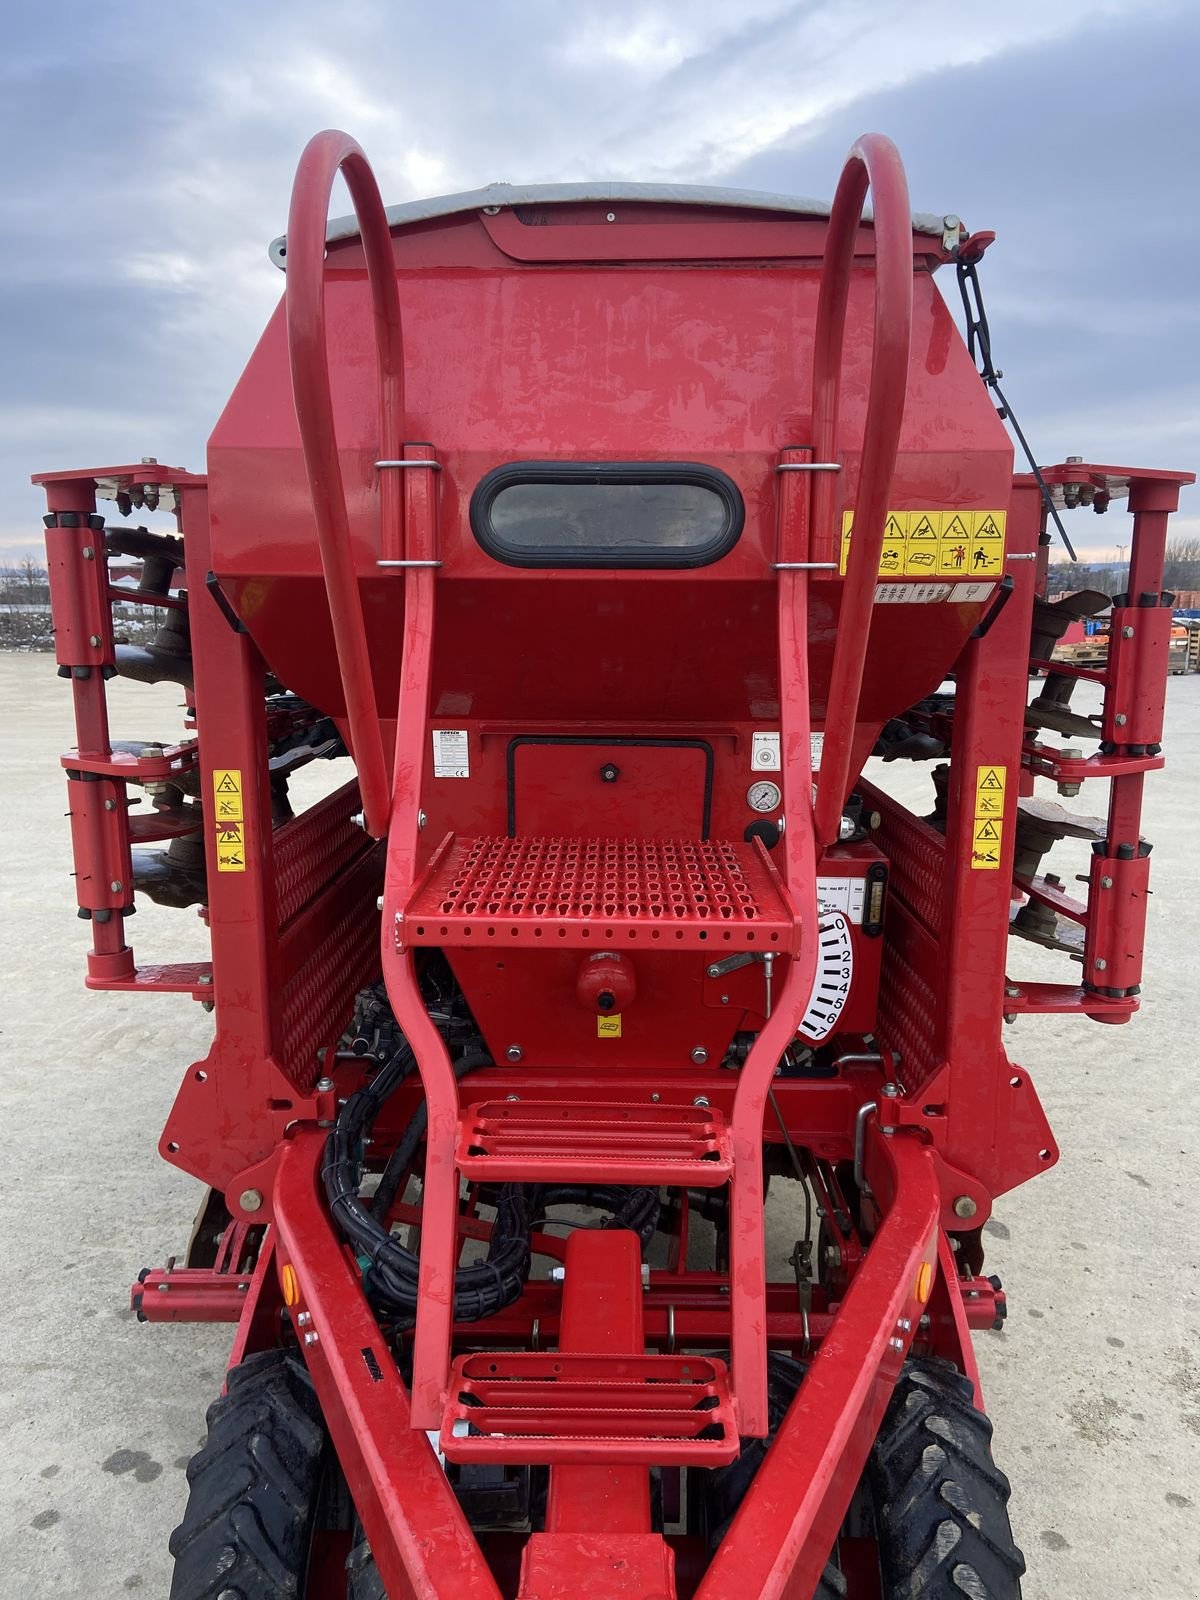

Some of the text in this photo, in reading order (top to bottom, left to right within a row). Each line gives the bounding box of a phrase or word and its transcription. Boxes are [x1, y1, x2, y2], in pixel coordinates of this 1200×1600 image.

[835, 918, 845, 930] 0
[840, 933, 848, 944] 1
[842, 951, 851, 962] 2
[842, 968, 850, 979] 3
[839, 982, 848, 994] 4
[834, 998, 844, 1009] 5
[827, 1013, 837, 1024] 6
[816, 1027, 827, 1037] 7
